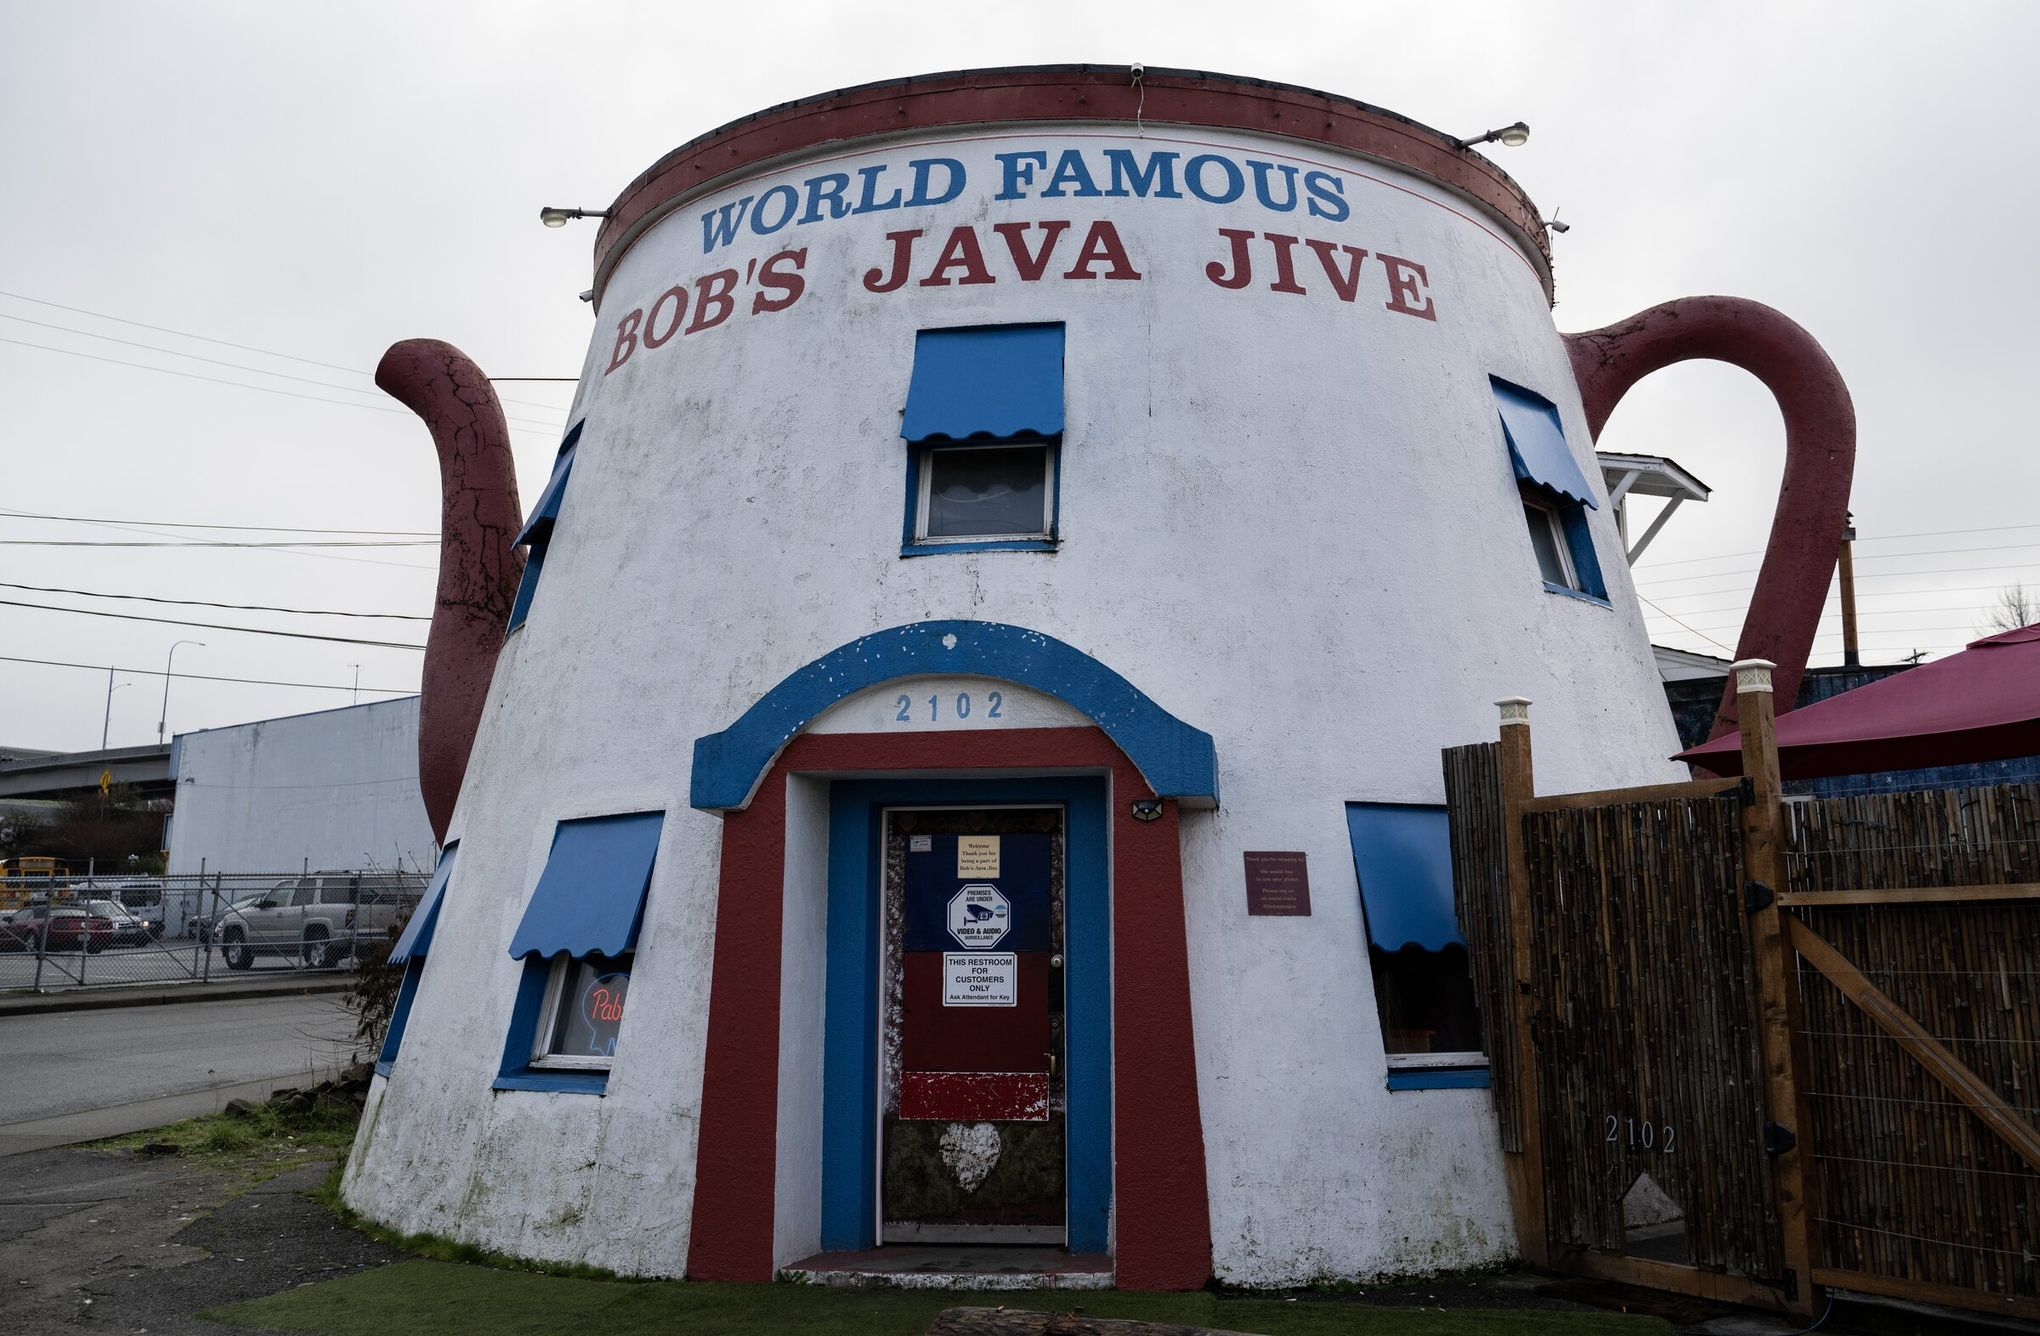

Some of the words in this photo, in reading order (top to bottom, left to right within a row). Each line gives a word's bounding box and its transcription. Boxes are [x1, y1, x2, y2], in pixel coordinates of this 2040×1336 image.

[701, 157, 967, 254] WORLD
[994, 147, 1351, 223] FAMOUS
[604, 247, 807, 376] BOB'S
[863, 220, 1141, 293] JAVA
[1205, 229, 1437, 321] JIVE
[896, 691, 1002, 721] 2102
[957, 927, 975, 935] VIDEO
[976, 927, 982, 935] &
[982, 927, 1002, 935] AUDIO
[949, 958, 966, 966] THIS
[968, 958, 1012, 966] RESTROOM
[971, 967, 988, 975] FOR
[1606, 1114, 1675, 1153] 2102
